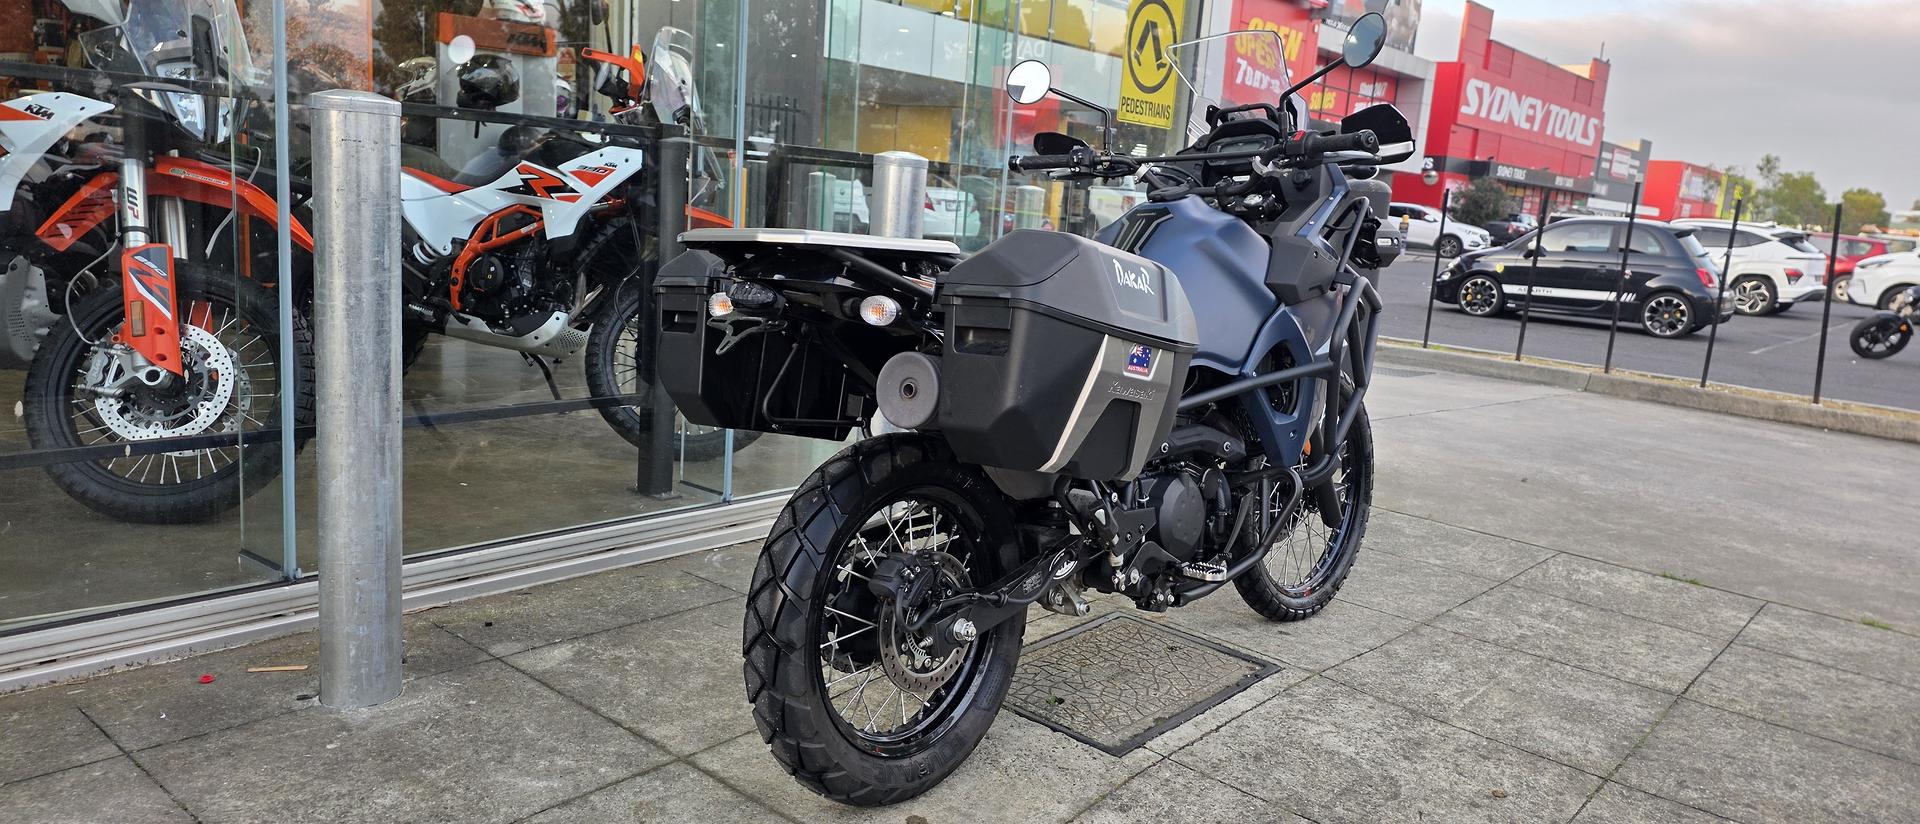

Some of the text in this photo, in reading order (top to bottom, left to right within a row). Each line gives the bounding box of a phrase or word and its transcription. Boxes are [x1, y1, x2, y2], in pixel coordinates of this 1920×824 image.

[24, 104, 55, 120] KTM
[1120, 96, 1171, 120] PEDESTRIANS
[1460, 78, 1600, 147] SYDNEY TOOLS
[126, 187, 139, 219] WP
[1518, 287, 1553, 295] ABRTH
[1127, 364, 1148, 373] AUSTRALIA
[1108, 379, 1156, 400] Kawasaki
